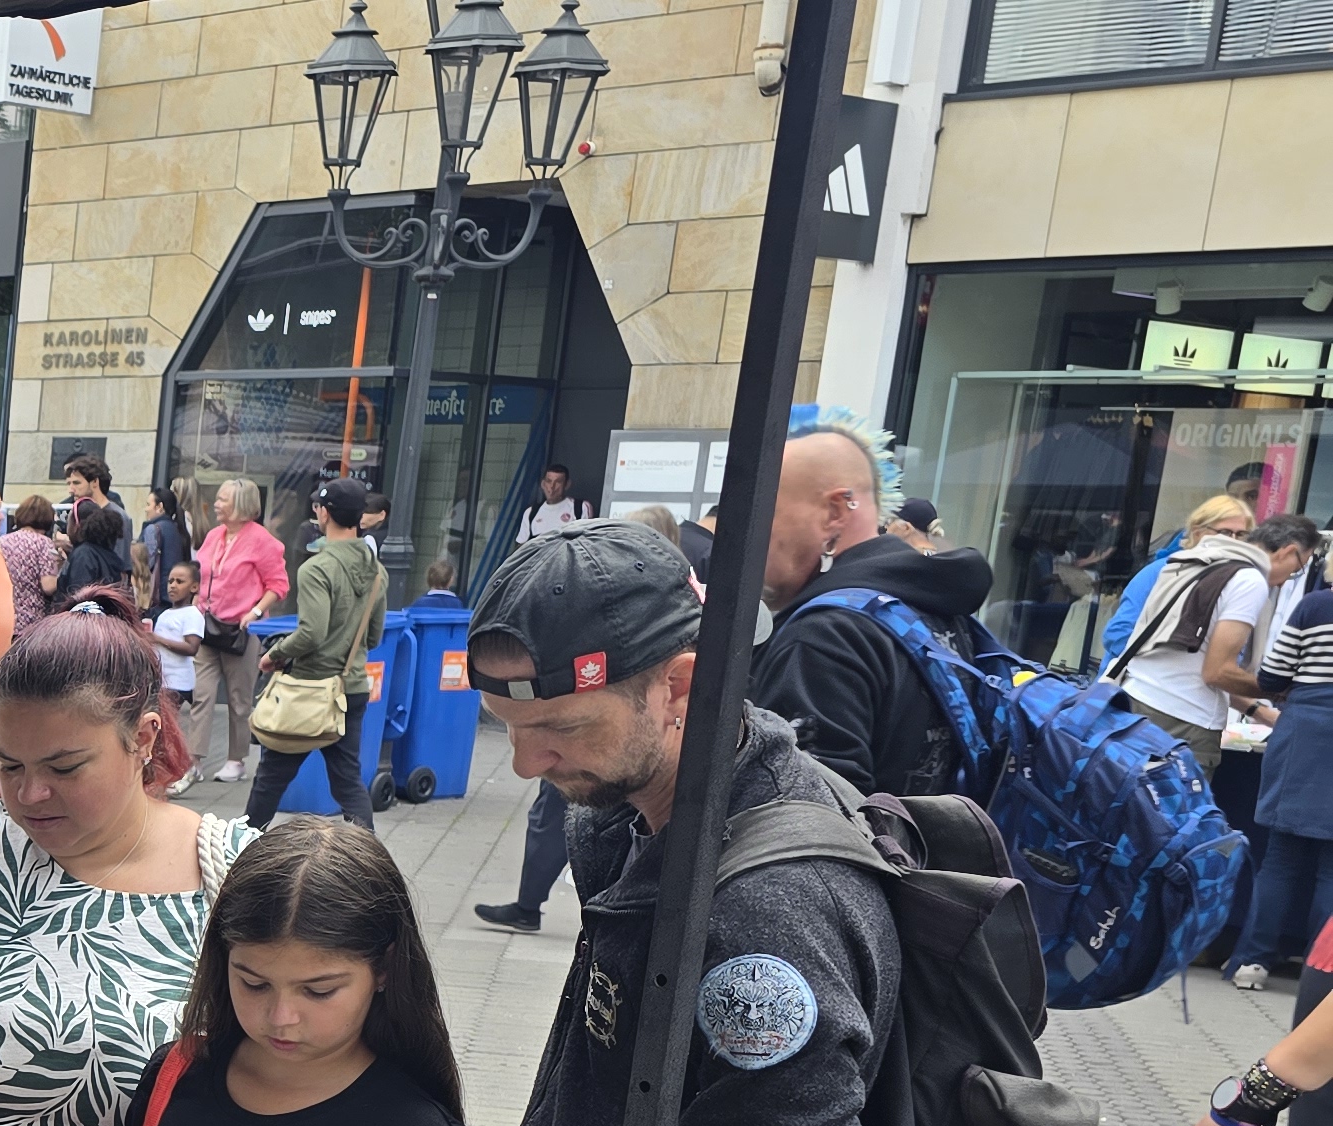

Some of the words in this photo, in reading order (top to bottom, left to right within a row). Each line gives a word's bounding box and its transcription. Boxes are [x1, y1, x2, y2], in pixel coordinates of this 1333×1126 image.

[10, 64, 92, 89] ZAHNÄRZTLICHE
[8, 83, 74, 106] TAGESKLINIK
[299, 309, 332, 327] snipes
[43, 327, 148, 347] KAROLINEN
[41, 351, 120, 370] STRASSE
[124, 351, 146, 367] 45
[1175, 423, 1303, 447] ORIGINALS
